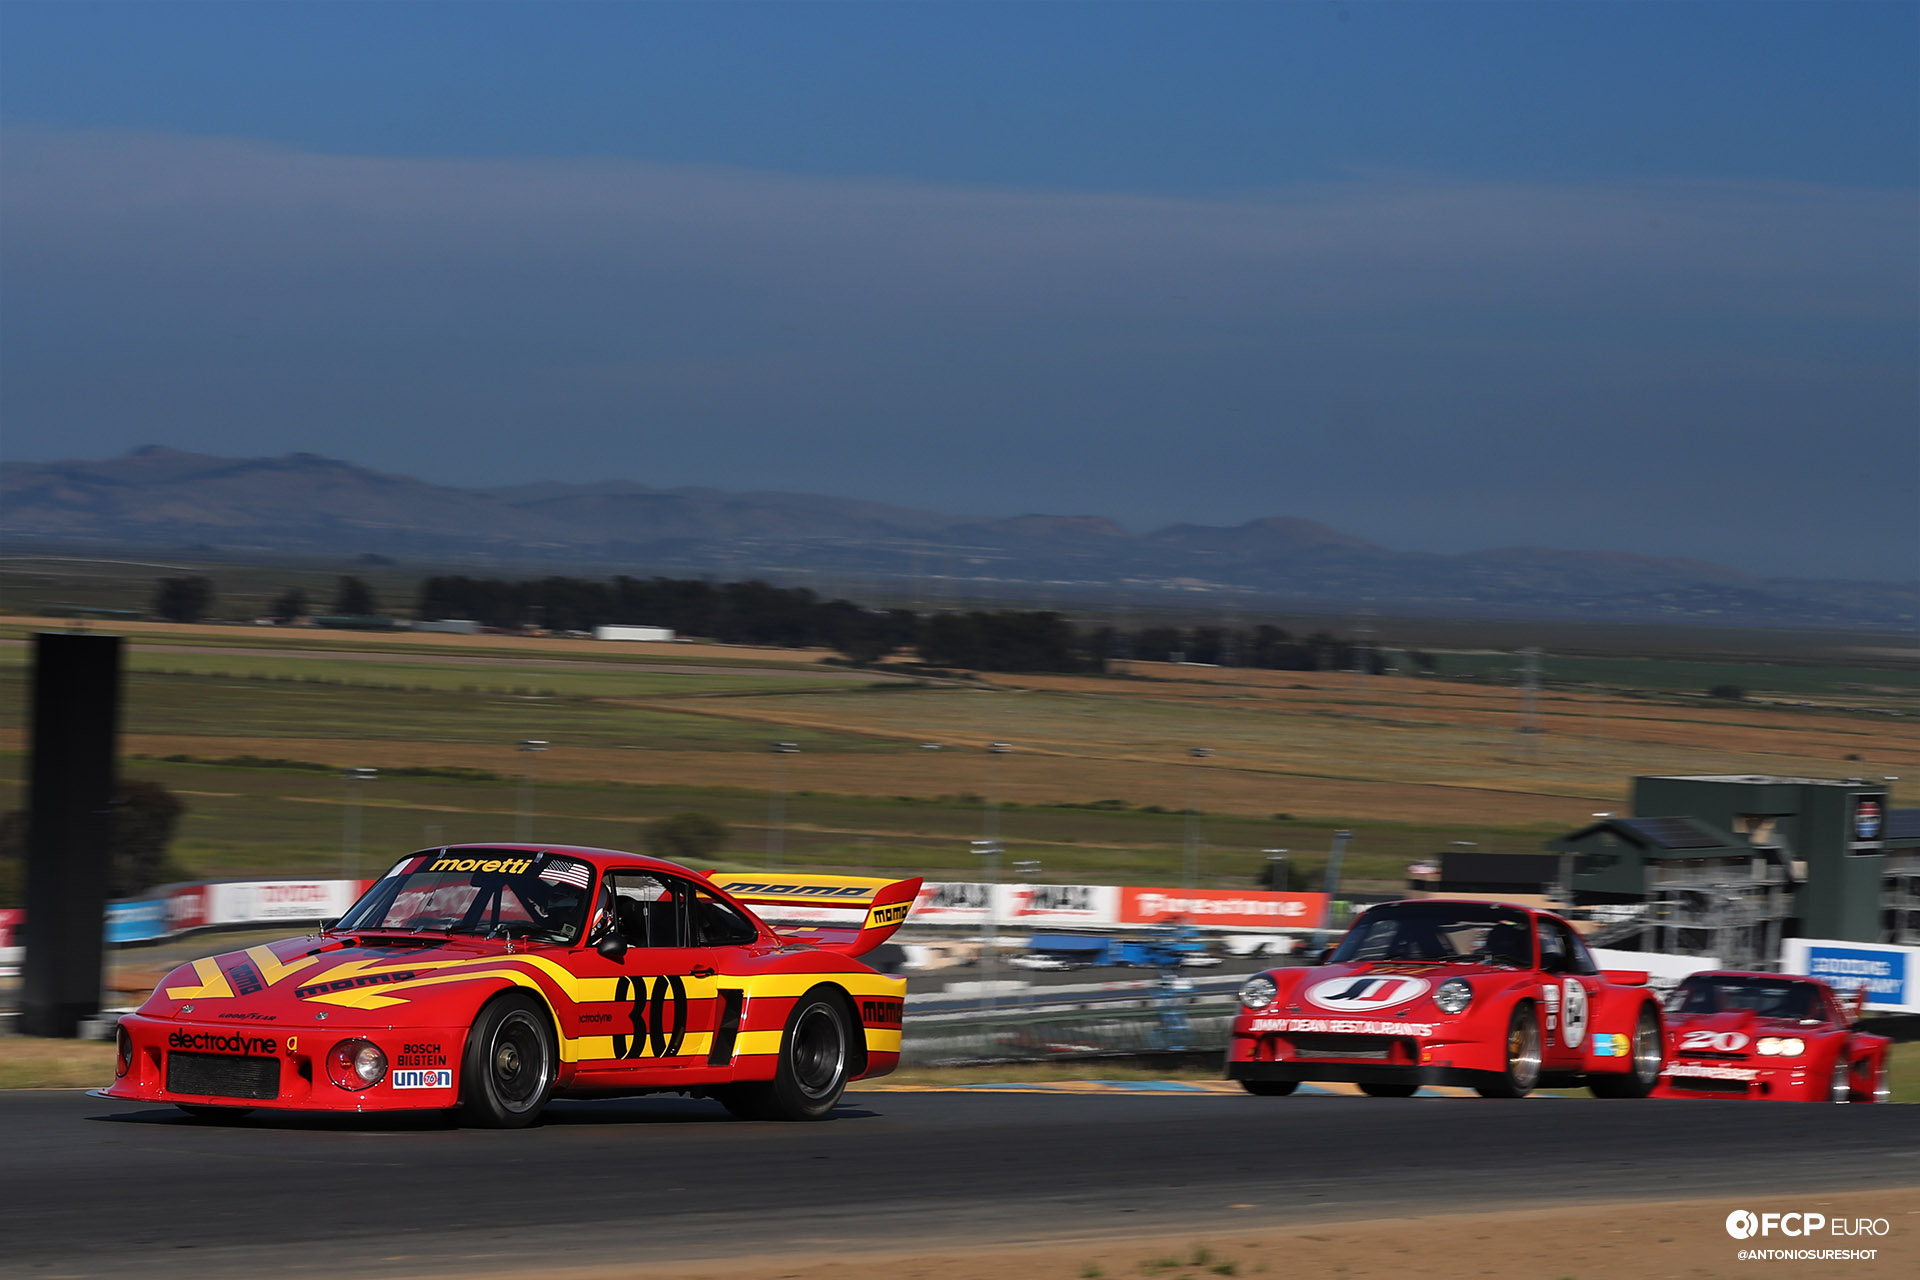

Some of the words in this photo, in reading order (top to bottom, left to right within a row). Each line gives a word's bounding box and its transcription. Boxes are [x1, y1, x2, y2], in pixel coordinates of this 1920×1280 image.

[429, 858, 532, 874] moretti
[721, 883, 872, 896] momo
[873, 905, 908, 924] momo
[294, 971, 416, 998] momo
[612, 974, 687, 1060] 30
[863, 1001, 903, 1023] momo
[168, 1028, 277, 1056] electrodyne
[403, 1044, 441, 1054] BOSCH
[1680, 1030, 1750, 1051] 20
[398, 1055, 446, 1066] BILSTEIN
